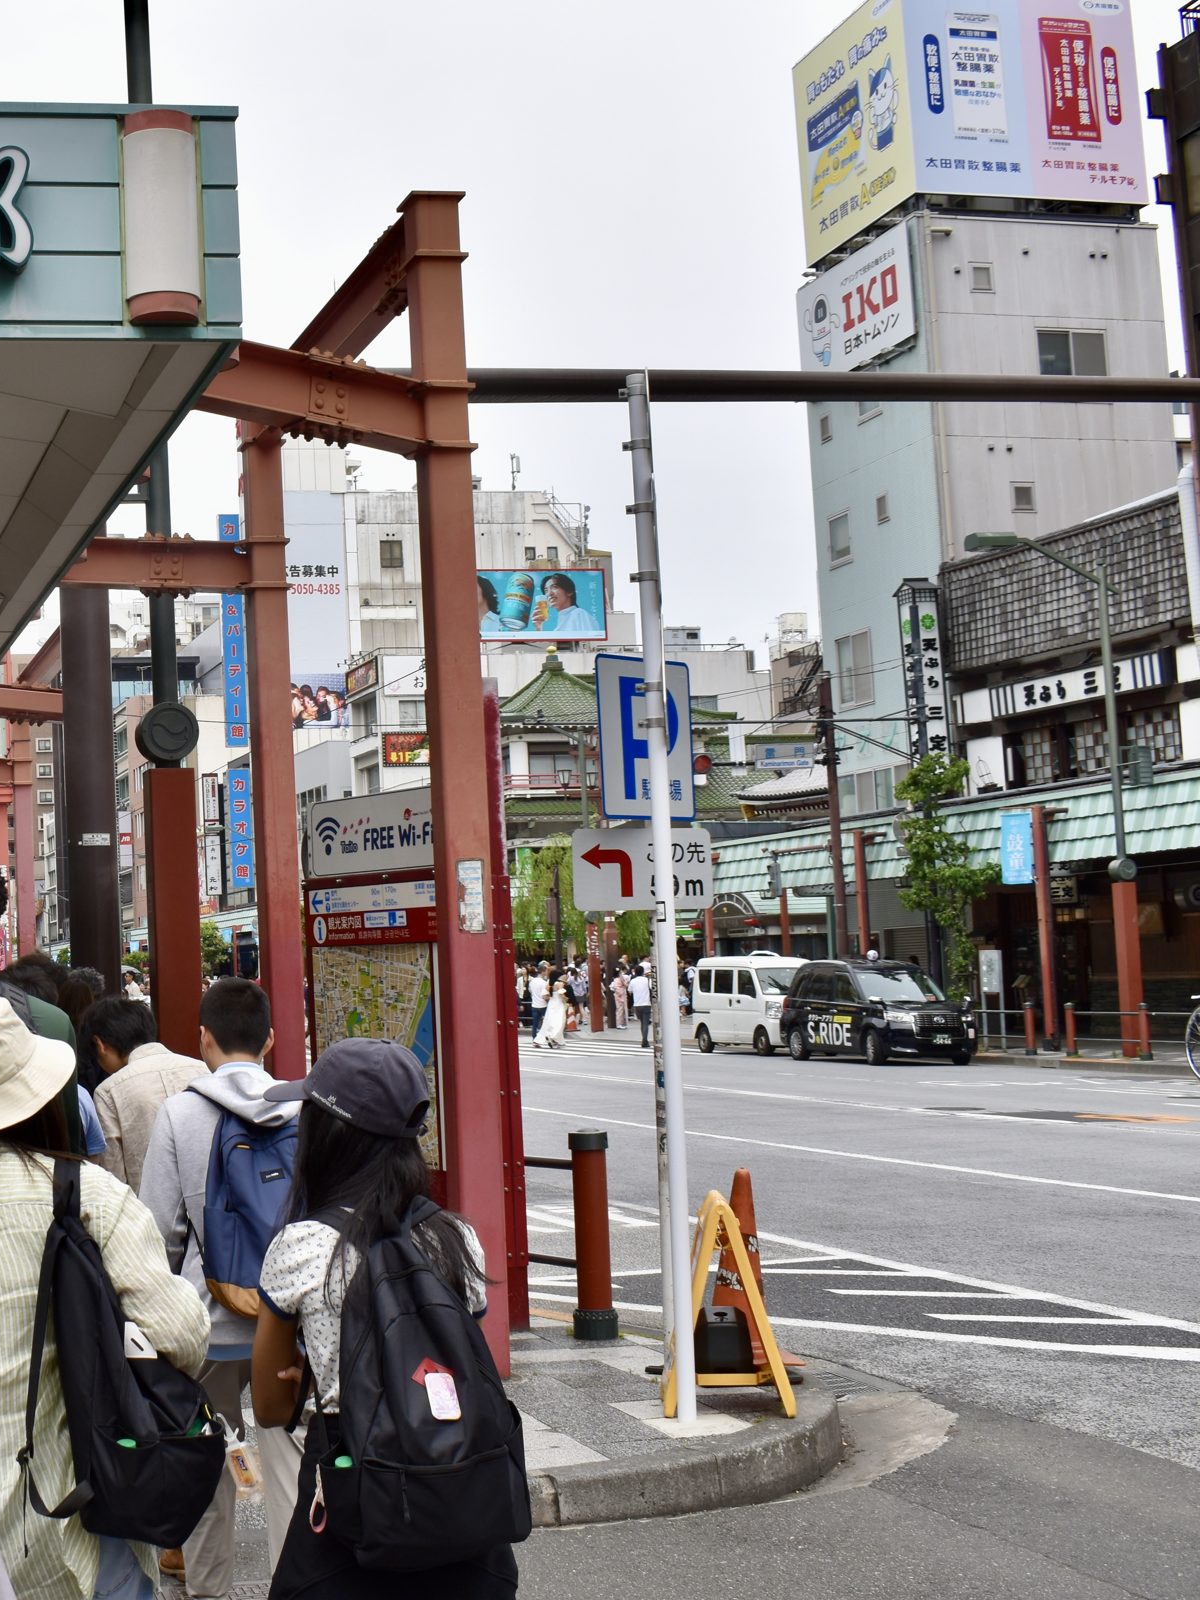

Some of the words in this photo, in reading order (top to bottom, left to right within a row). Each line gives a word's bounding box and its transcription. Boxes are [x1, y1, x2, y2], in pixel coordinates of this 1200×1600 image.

[951, 52, 999, 63] 太田胃散
[926, 158, 1021, 173] 太田胃散整腸薬
[1042, 160, 1120, 172] 太田胃散整腸薬
[842, 264, 898, 333] IKO
[844, 313, 899, 355] 日本トムソン
[922, 638, 939, 688] 天ぷら
[1023, 680, 1067, 707] 天ぷら
[619, 676, 679, 800] P
[928, 706, 947, 751] 三定
[761, 760, 795, 768] Kaminarimon
[233, 779, 250, 878] カラオケ館
[363, 826, 395, 850] FREE
[328, 916, 361, 929] 観光案内図
[328, 932, 355, 941] Information
